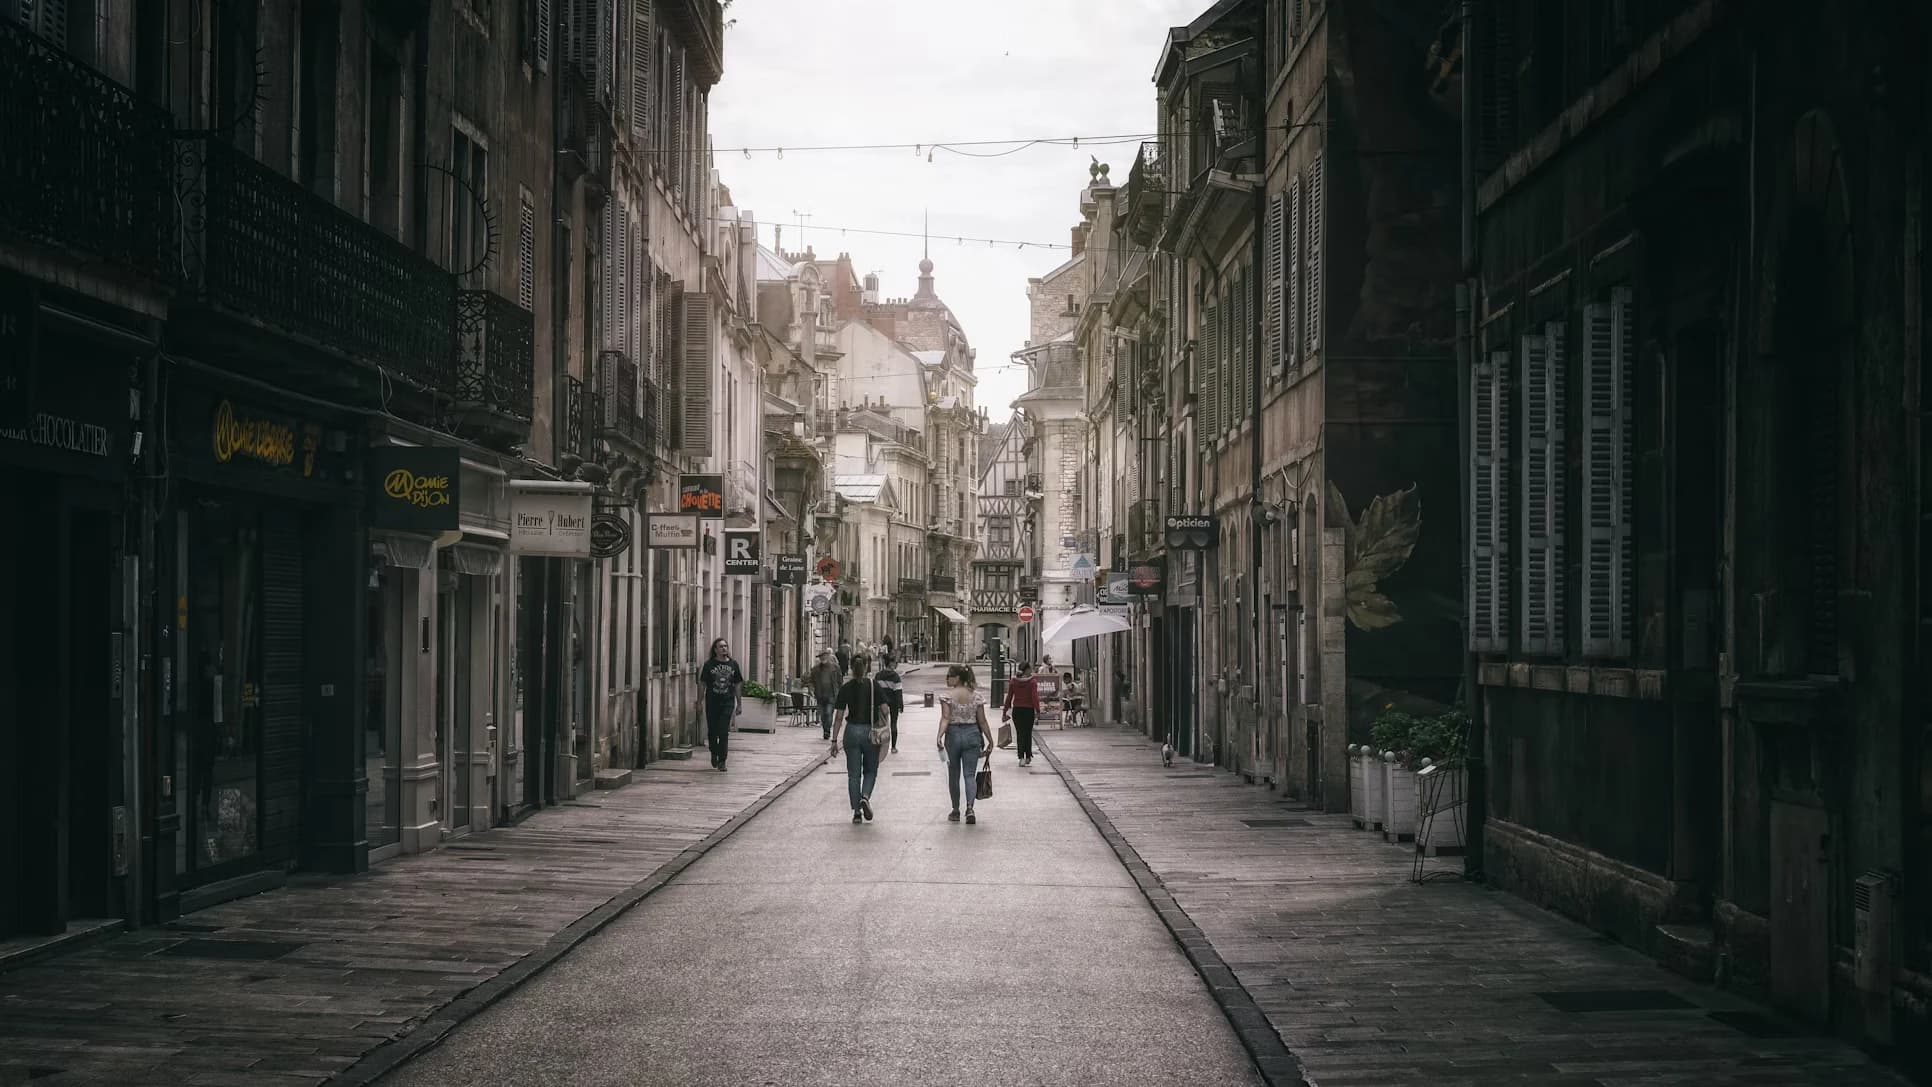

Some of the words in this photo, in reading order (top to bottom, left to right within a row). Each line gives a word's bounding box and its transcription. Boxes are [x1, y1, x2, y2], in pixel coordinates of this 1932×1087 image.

[30, 412, 108, 457] CHOCOLATIER
[517, 513, 543, 527] Pierre
[557, 514, 585, 529] Hubert
[1167, 517, 1211, 530] Opticien
[730, 538, 752, 559] R
